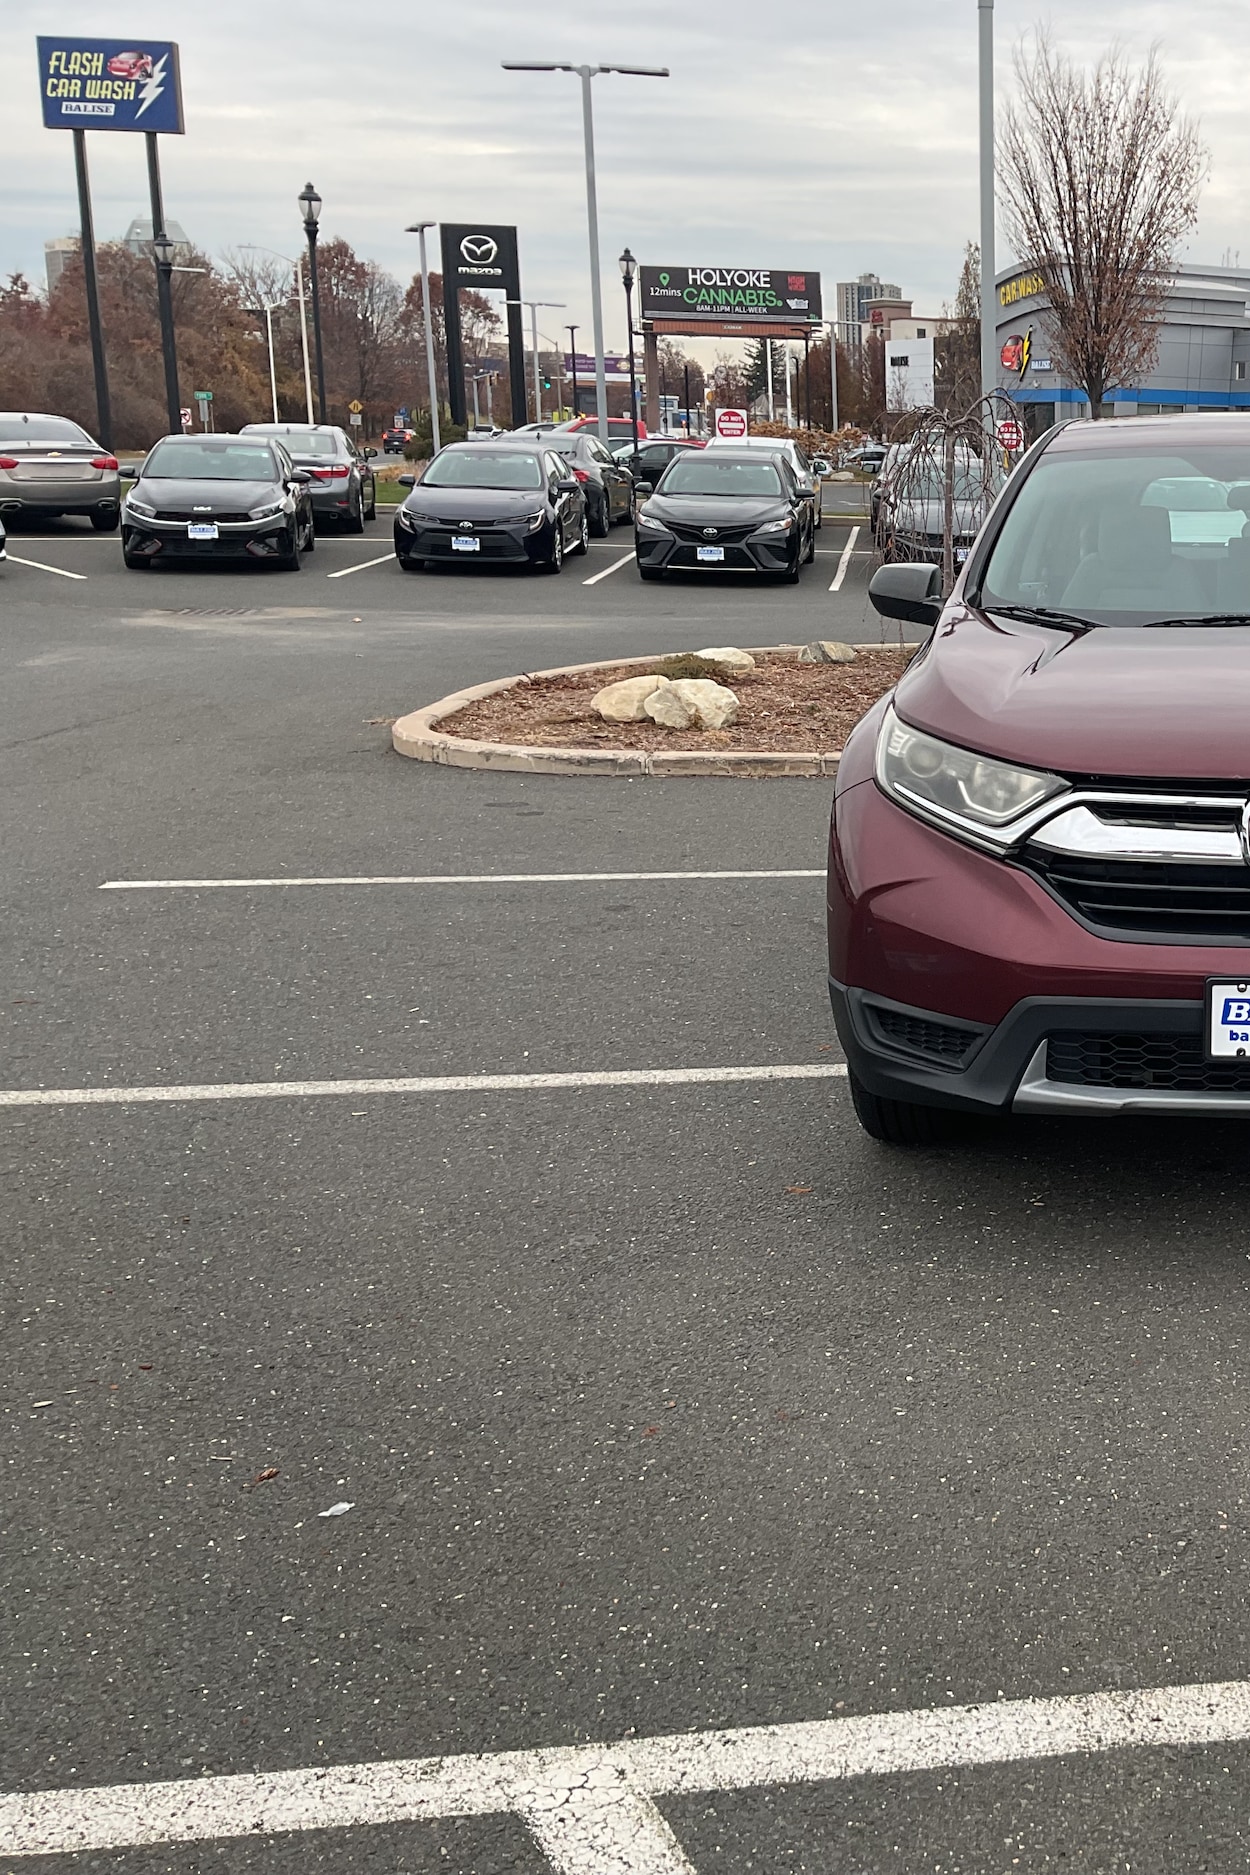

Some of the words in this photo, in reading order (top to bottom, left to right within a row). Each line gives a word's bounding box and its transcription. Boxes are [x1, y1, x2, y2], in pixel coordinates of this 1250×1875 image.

[49, 51, 104, 76] FLASH
[46, 78, 81, 98] CAR
[85, 80, 136, 100] WASH
[64, 103, 113, 113] BALISE
[688, 268, 771, 288] HOLYOKE
[649, 287, 682, 296] 12mins
[1000, 281, 1017, 306] CAR
